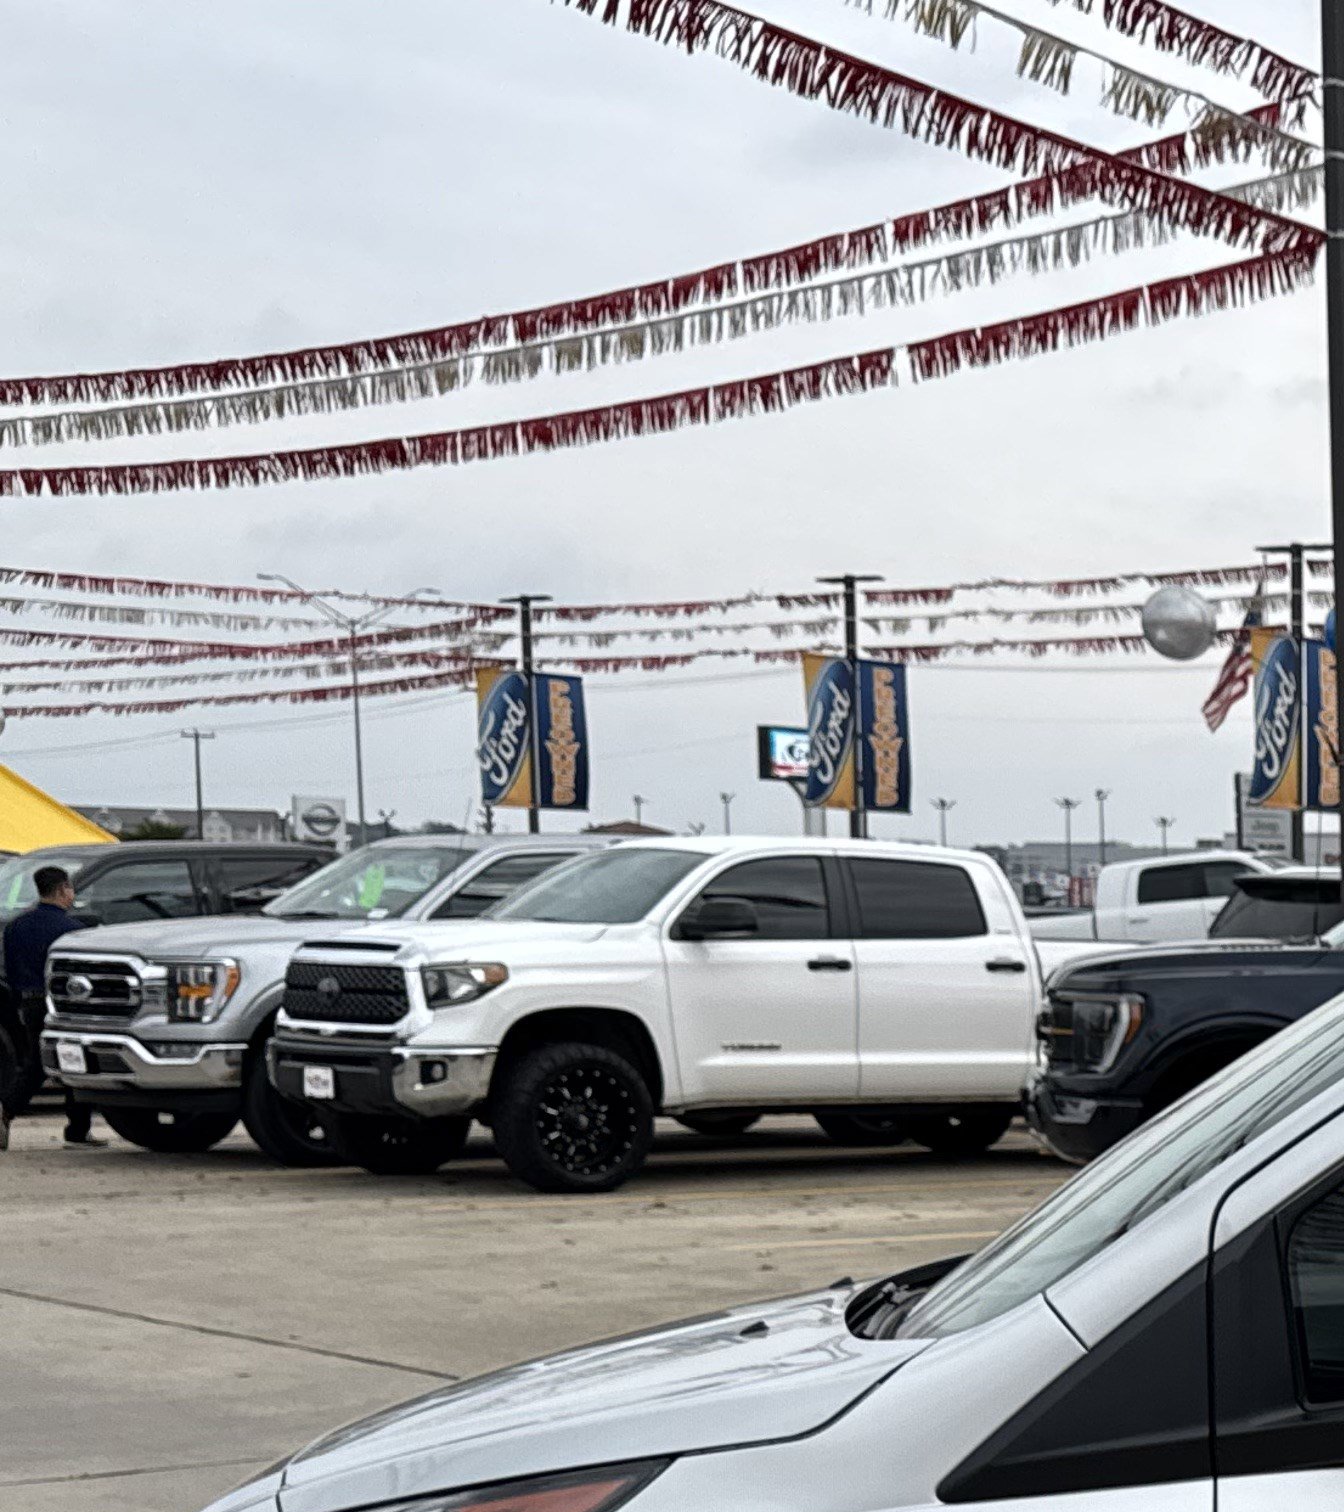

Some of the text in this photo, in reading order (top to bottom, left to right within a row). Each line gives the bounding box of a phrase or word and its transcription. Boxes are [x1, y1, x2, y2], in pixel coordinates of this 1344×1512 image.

[478, 691, 527, 787] Ford
[809, 680, 851, 784] Ford
[1255, 661, 1297, 779] Ford
